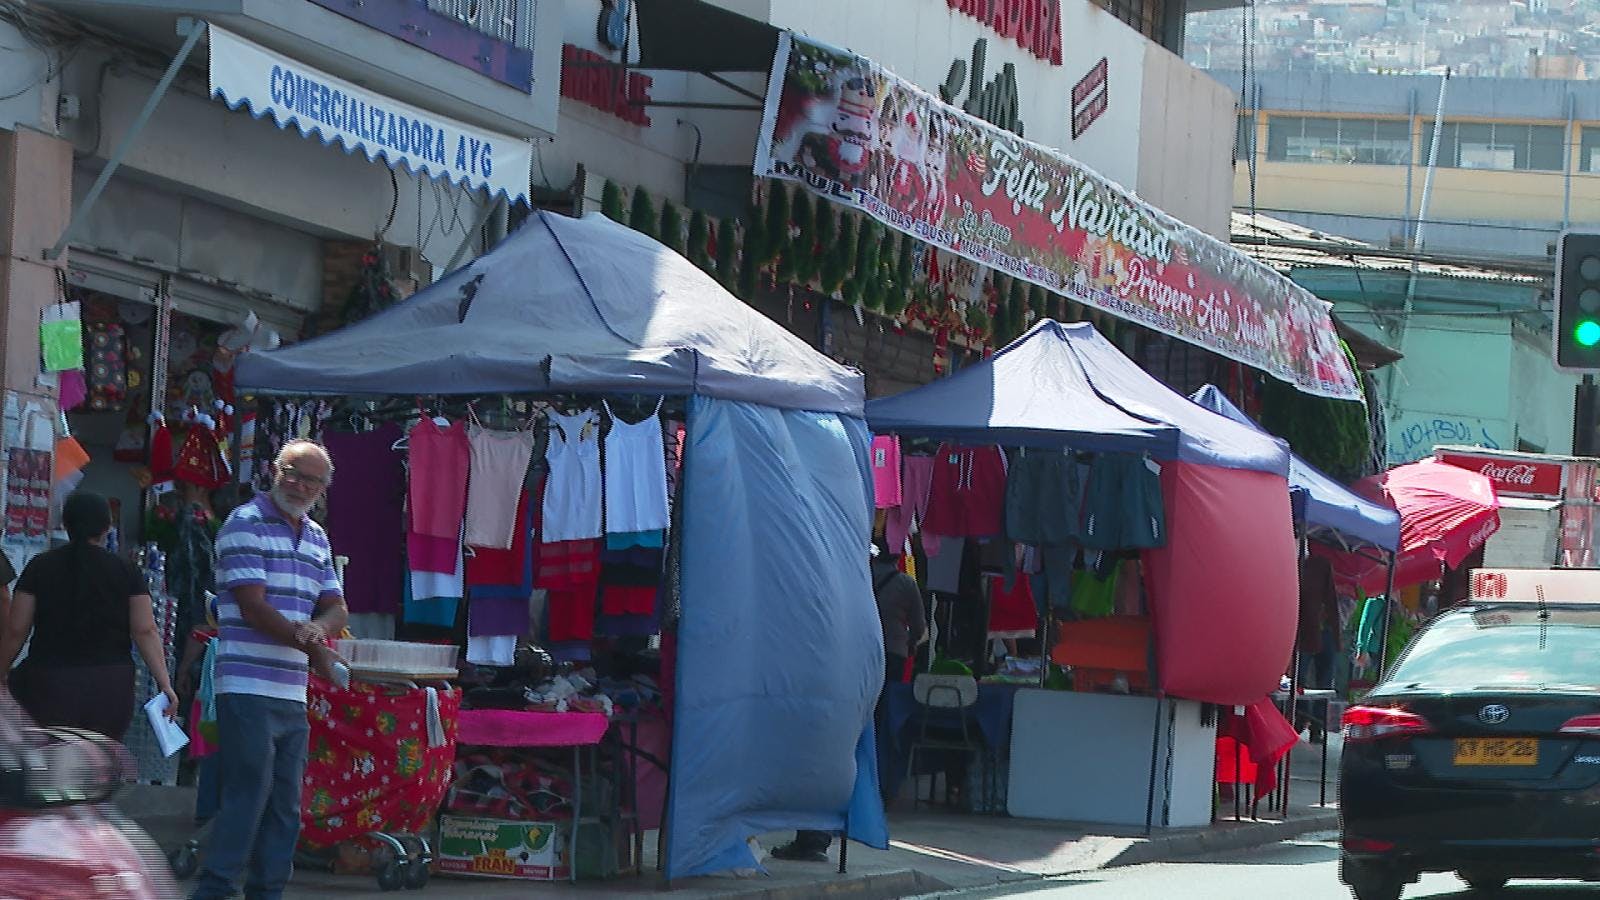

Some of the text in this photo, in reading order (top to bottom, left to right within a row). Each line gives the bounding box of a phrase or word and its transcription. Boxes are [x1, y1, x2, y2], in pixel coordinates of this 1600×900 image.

[270, 65, 493, 178] COMERCIALIZADORA AYG
[982, 141, 1173, 265] Feliz Navidad
[1472, 573, 1508, 599] 070
[474, 856, 514, 874] FRAN
